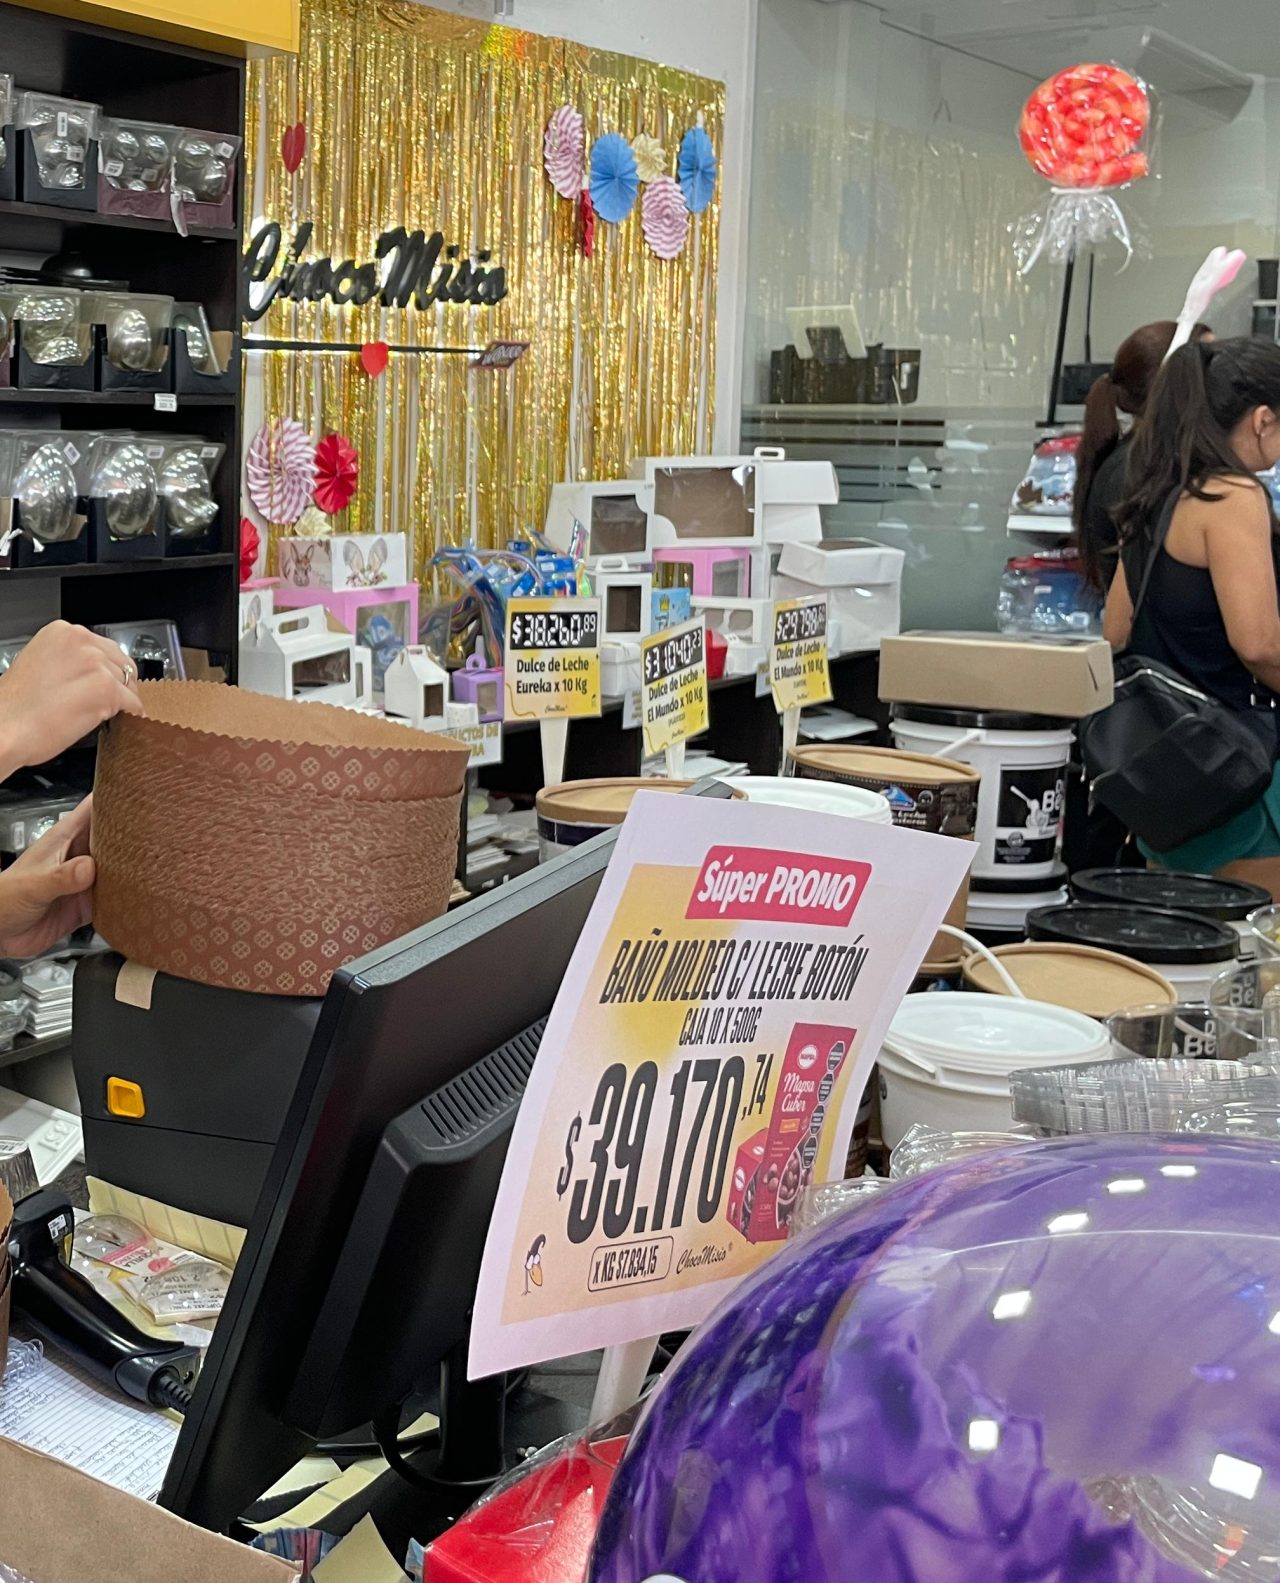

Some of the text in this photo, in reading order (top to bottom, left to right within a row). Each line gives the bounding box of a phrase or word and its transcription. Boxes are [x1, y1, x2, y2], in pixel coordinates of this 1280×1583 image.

[517, 656, 589, 673] Dulce de Leche
[776, 641, 820, 660] Dulce de Leche
[516, 677, 587, 695] Eureka x 10 Kg
[648, 668, 698, 701] Dulce de Leche
[775, 667, 780, 680] El
[781, 662, 802, 679] Mundo
[807, 660, 814, 672] 10
[816, 658, 823, 674] Kg
[648, 707, 654, 722] El
[655, 698, 679, 719] Mundo
[685, 691, 693, 705] 10
[694, 686, 703, 703] Kg
[697, 854, 857, 914] Súper PROMO
[599, 927, 870, 1004] BAÑO MOLDEO C/ LECHE BOTÓN
[679, 1006, 762, 1046] CAJA 10 X 500G
[592, 1245, 659, 1284] x KG $7.834,15
